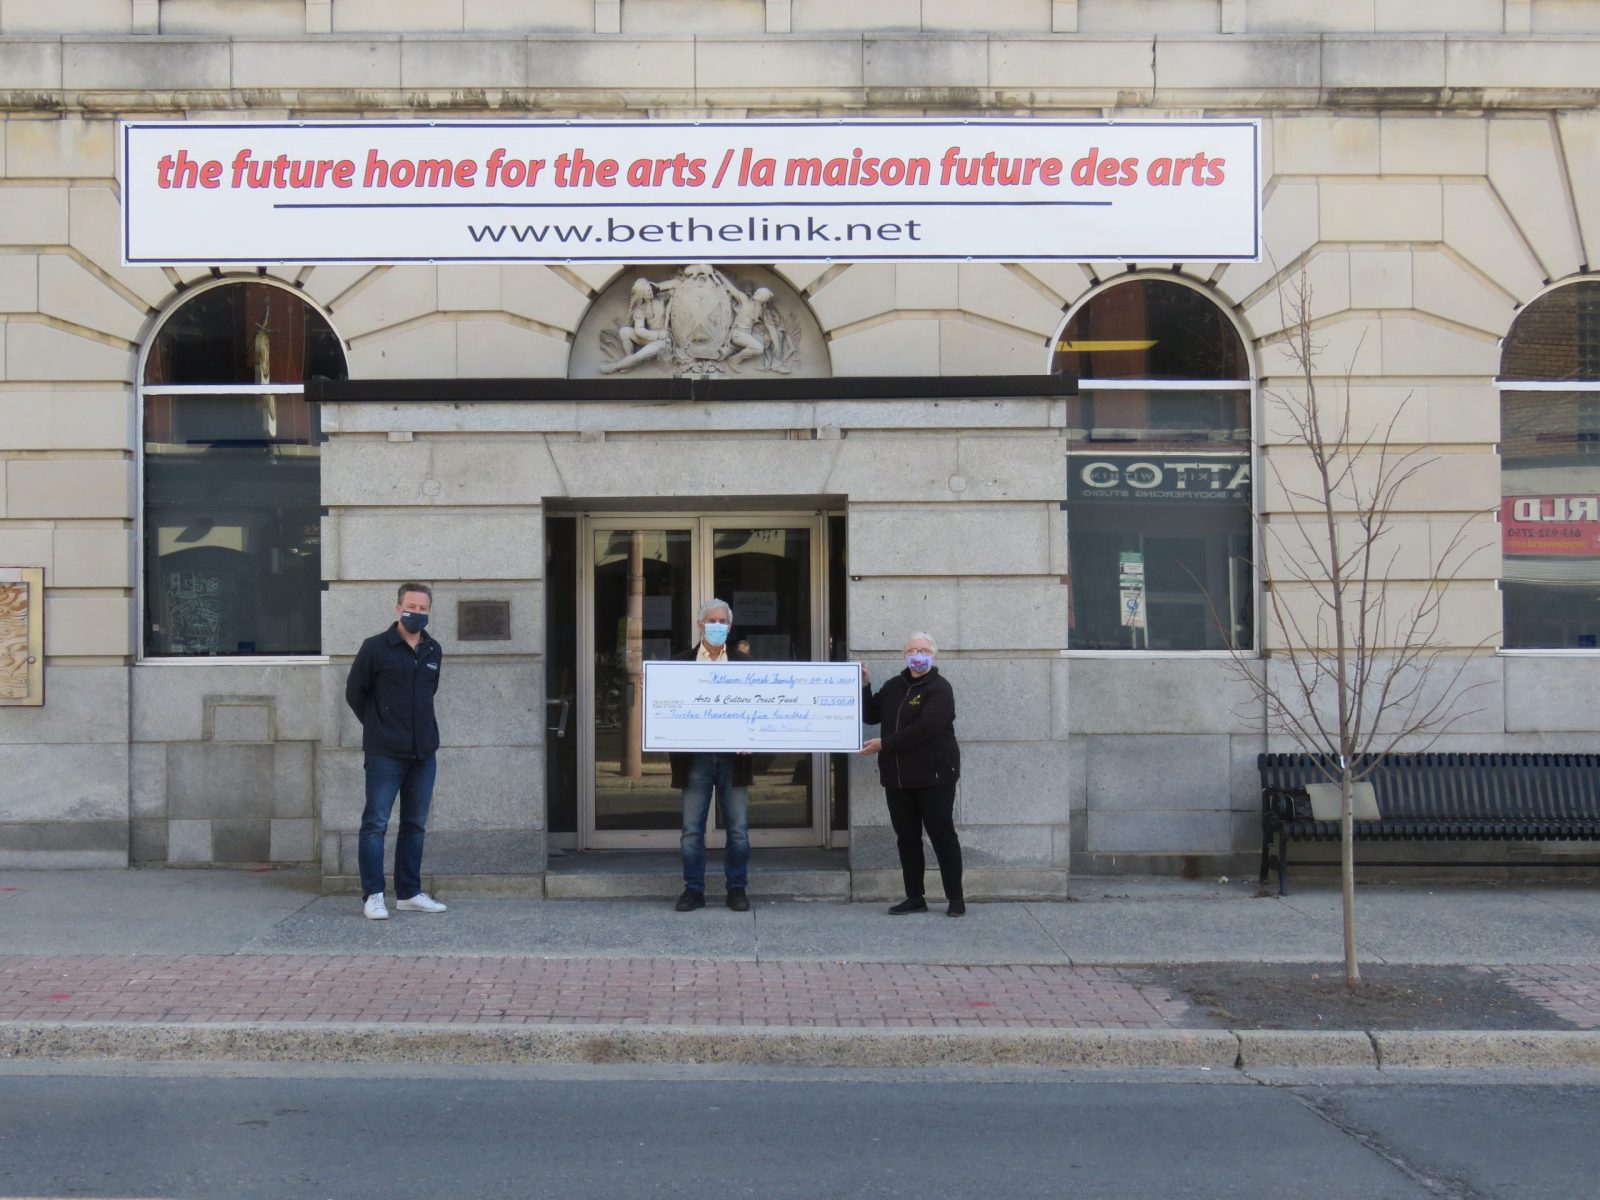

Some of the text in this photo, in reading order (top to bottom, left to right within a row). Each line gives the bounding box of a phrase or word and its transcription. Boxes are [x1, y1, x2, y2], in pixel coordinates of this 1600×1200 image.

[157, 149, 222, 189] the
[231, 149, 353, 188] future
[363, 149, 478, 188] home
[485, 148, 546, 188] for
[554, 148, 617, 188] the
[627, 151, 706, 187] arts
[738, 148, 776, 187] la
[785, 148, 931, 187] maison
[940, 147, 1063, 187] future
[1071, 148, 1137, 187] des
[1147, 152, 1226, 187] arts
[467, 217, 922, 243] www.bethelink.net
[692, 694, 712, 704] Arts
[714, 694, 720, 703] &
[723, 695, 752, 705] Culture
[754, 694, 775, 704] Trust
[777, 695, 799, 705] Fund
[812, 696, 817, 705] $
